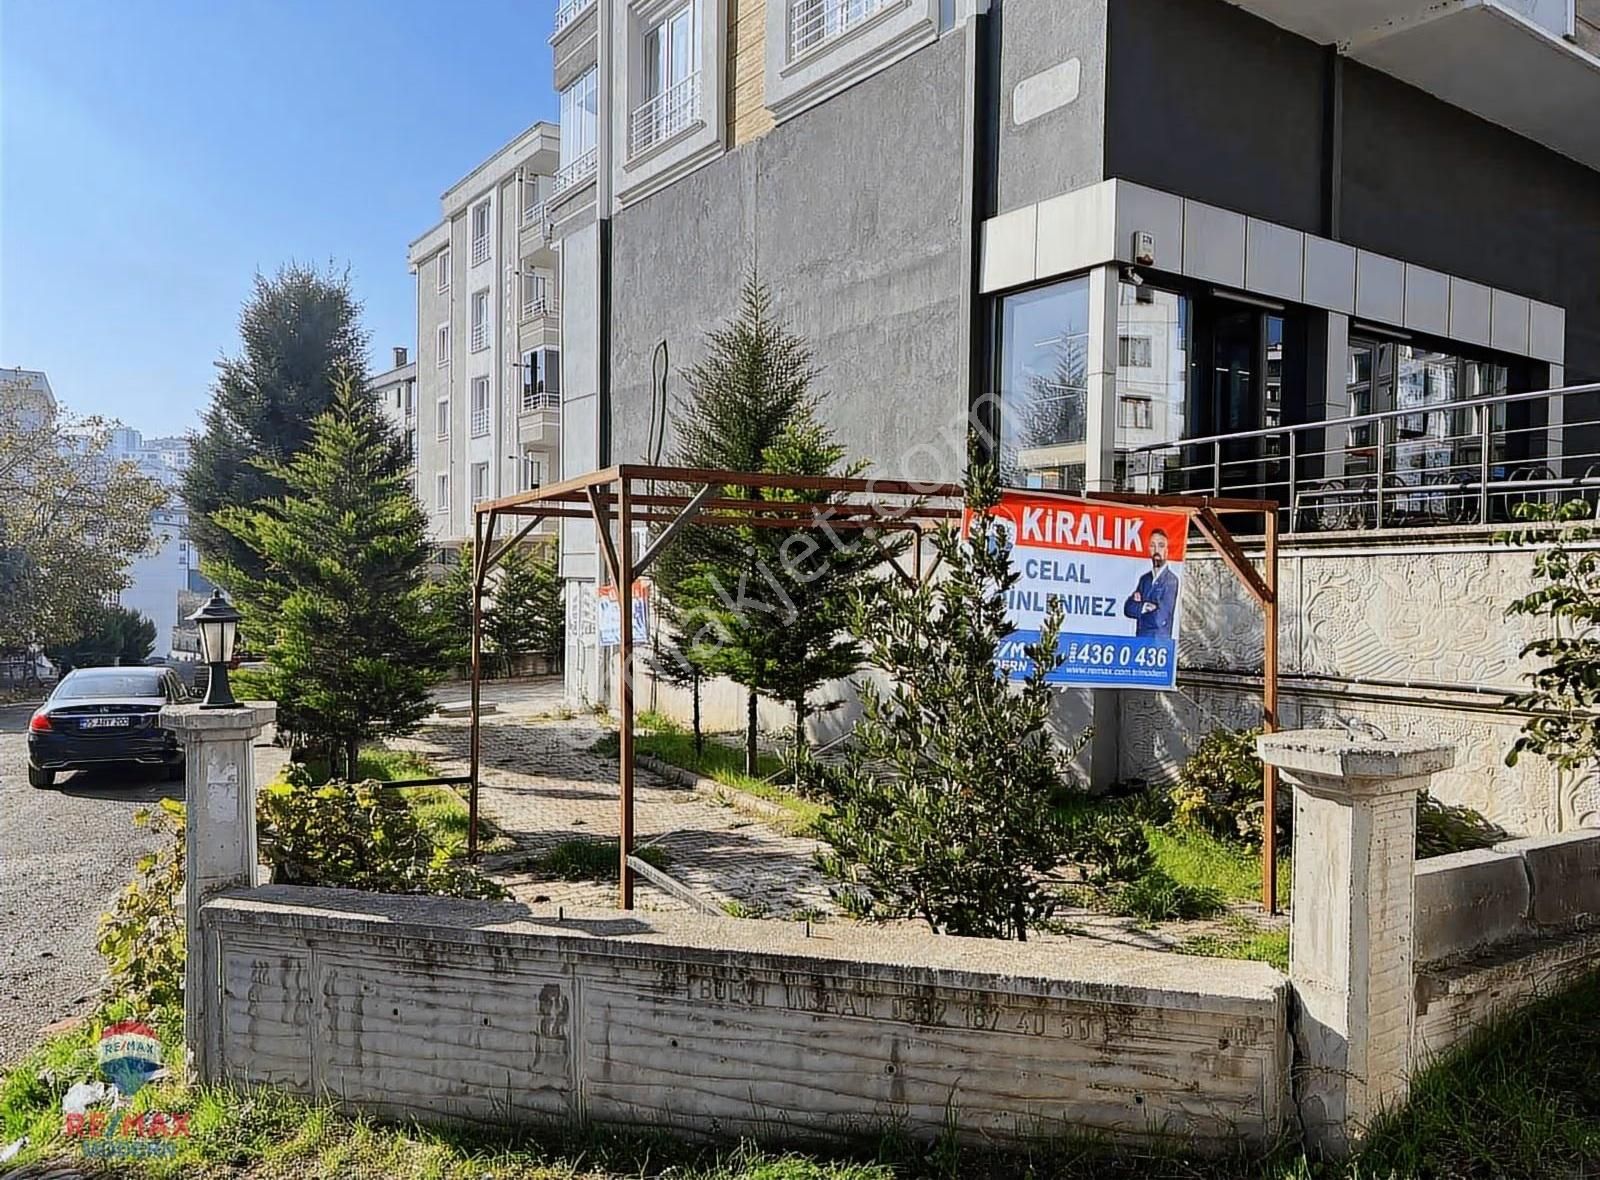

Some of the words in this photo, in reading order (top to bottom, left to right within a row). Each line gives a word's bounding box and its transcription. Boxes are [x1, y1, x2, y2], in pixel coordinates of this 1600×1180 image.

[1025, 558, 1091, 583] CELAL
[1077, 643, 1115, 665] 436
[1119, 646, 1131, 666] 0
[1134, 646, 1167, 667] 436
